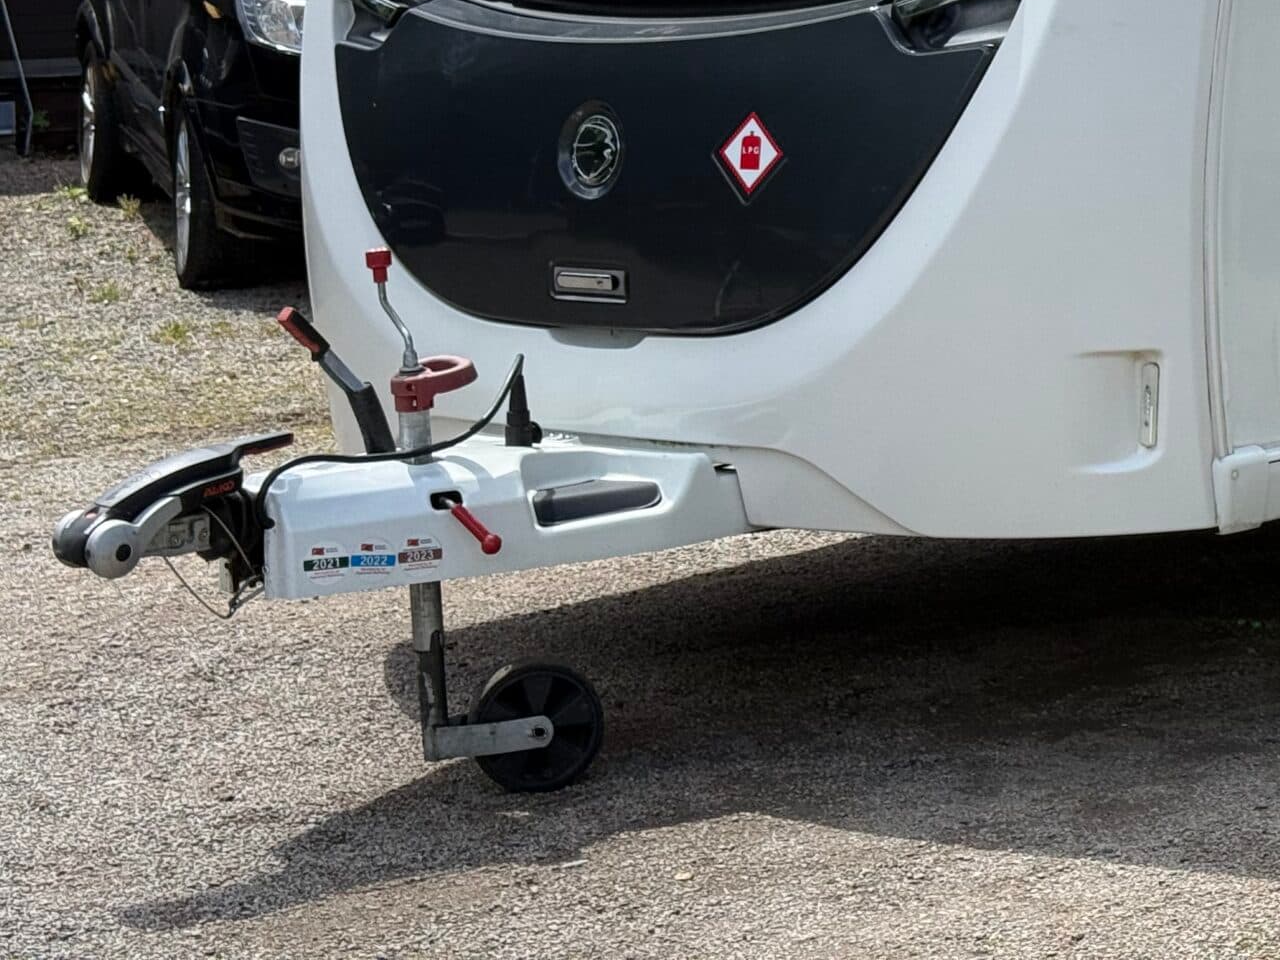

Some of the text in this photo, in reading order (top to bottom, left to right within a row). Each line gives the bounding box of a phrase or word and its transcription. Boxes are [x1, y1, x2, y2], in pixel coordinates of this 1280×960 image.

[742, 146, 760, 155] LPG
[360, 555, 388, 566] 2022
[406, 550, 435, 561] 2023
[312, 558, 340, 570] 2021
